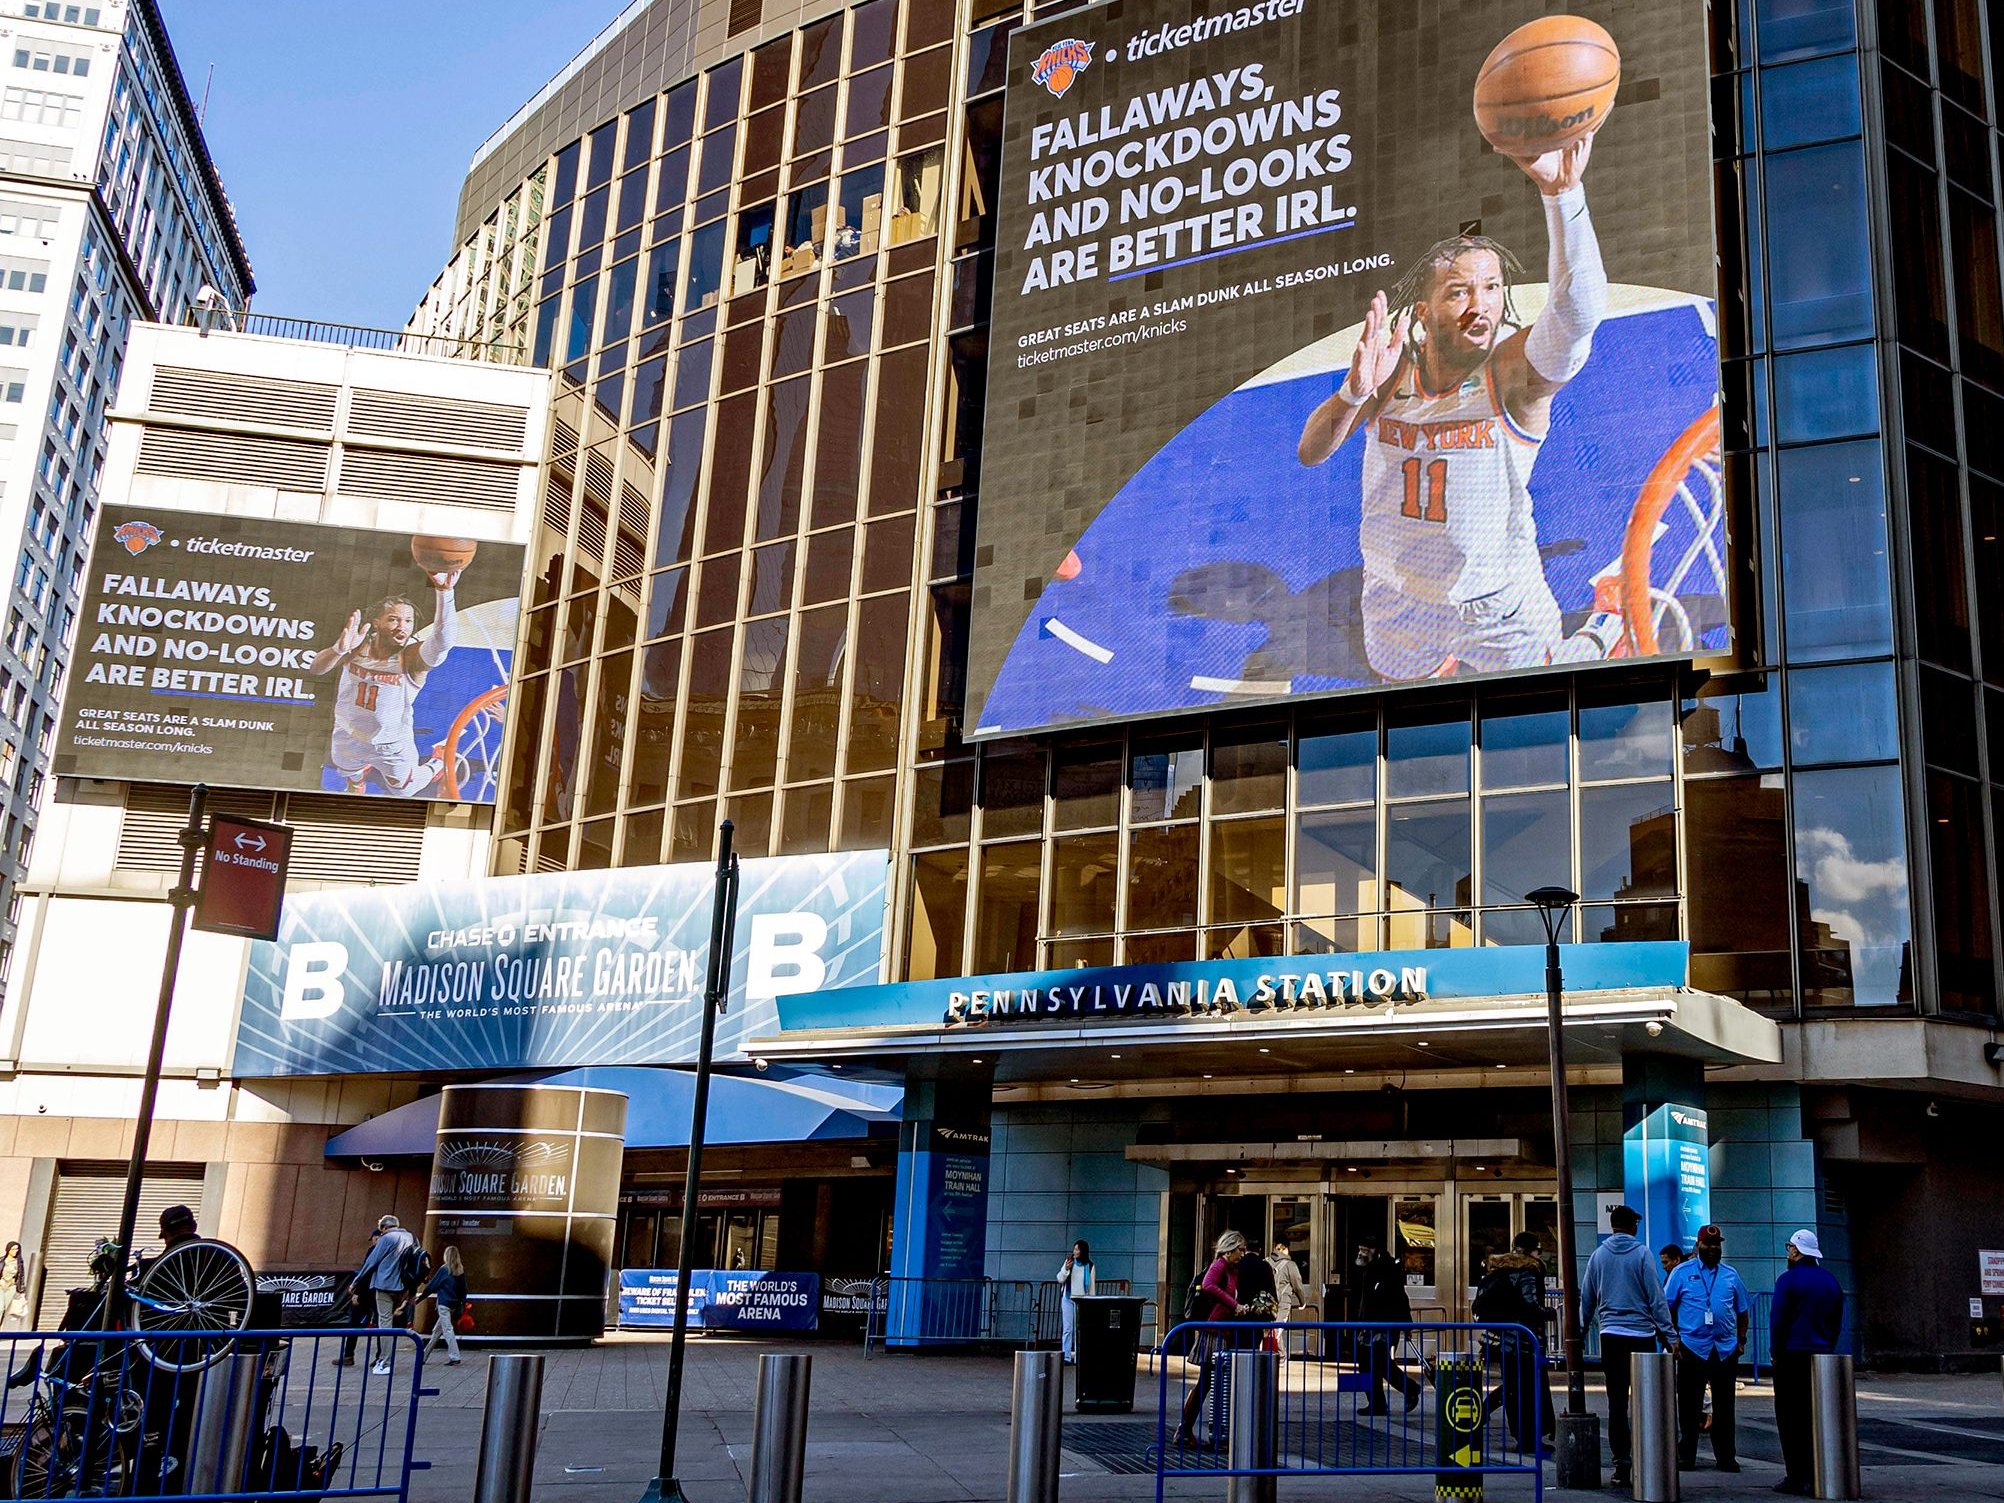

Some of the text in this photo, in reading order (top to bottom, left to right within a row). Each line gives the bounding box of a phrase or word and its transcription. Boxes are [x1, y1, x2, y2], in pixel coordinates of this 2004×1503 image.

[1126, 0, 1304, 62] ticketmaster
[1030, 62, 1275, 161] FALLAWAYS,
[1027, 88, 1342, 205] KNOCKDOWNS
[1023, 133, 1353, 251] AND NO-LOOKS
[1020, 184, 1358, 296] ARE BETTER IRL.
[1017, 253, 1396, 349] GREAT SEATS ARE A SLAM DUNK ALL SEASON LONG.
[1016, 318, 1187, 369] ticketmaster.com/knicks
[1378, 416, 1496, 450] NEW YORK
[1401, 457, 1448, 524] 11
[186, 536, 315, 563] ticketmaster
[102, 573, 278, 612] FALLAWAYS,
[97, 603, 316, 641] KNOCKDOWNS
[90, 633, 318, 670] AND NO-LOOKS
[84, 662, 316, 700] ARE BETTER IRL.
[355, 681, 379, 712] 11
[75, 719, 196, 737] ALL SEASON LONG.
[78, 708, 275, 731] GREAT SEATS ARE A SLAM DUNK
[73, 735, 213, 755] ticketmaster.com/knicks
[214, 850, 279, 874] No Standing
[427, 917, 659, 949] CHASE ENTRANCE
[745, 911, 828, 1000] B
[280, 941, 349, 1021] B
[378, 960, 486, 1007] MADISON
[490, 953, 588, 1003] SQUARE
[947, 966, 1429, 1020] PENNSYLVANIA STATION
[419, 1010, 442, 1020] THE
[446, 1007, 499, 1018] WORLD'S
[503, 1005, 538, 1017] MOST
[541, 1002, 593, 1014] FAMOUS
[952, 1132, 989, 1143] AMTRAK
[459, 1170, 507, 1195] SQUARE
[945, 1169, 982, 1182] MOYNIHAN
[945, 1181, 981, 1193] TRAIN HALL
[636, 1297, 661, 1306] TICKET
[715, 1292, 808, 1306] MOST FAMOUS
[726, 1280, 798, 1292] THE WORLD'S
[822, 1294, 850, 1309] MADISON
[737, 1306, 782, 1321] ARENA
